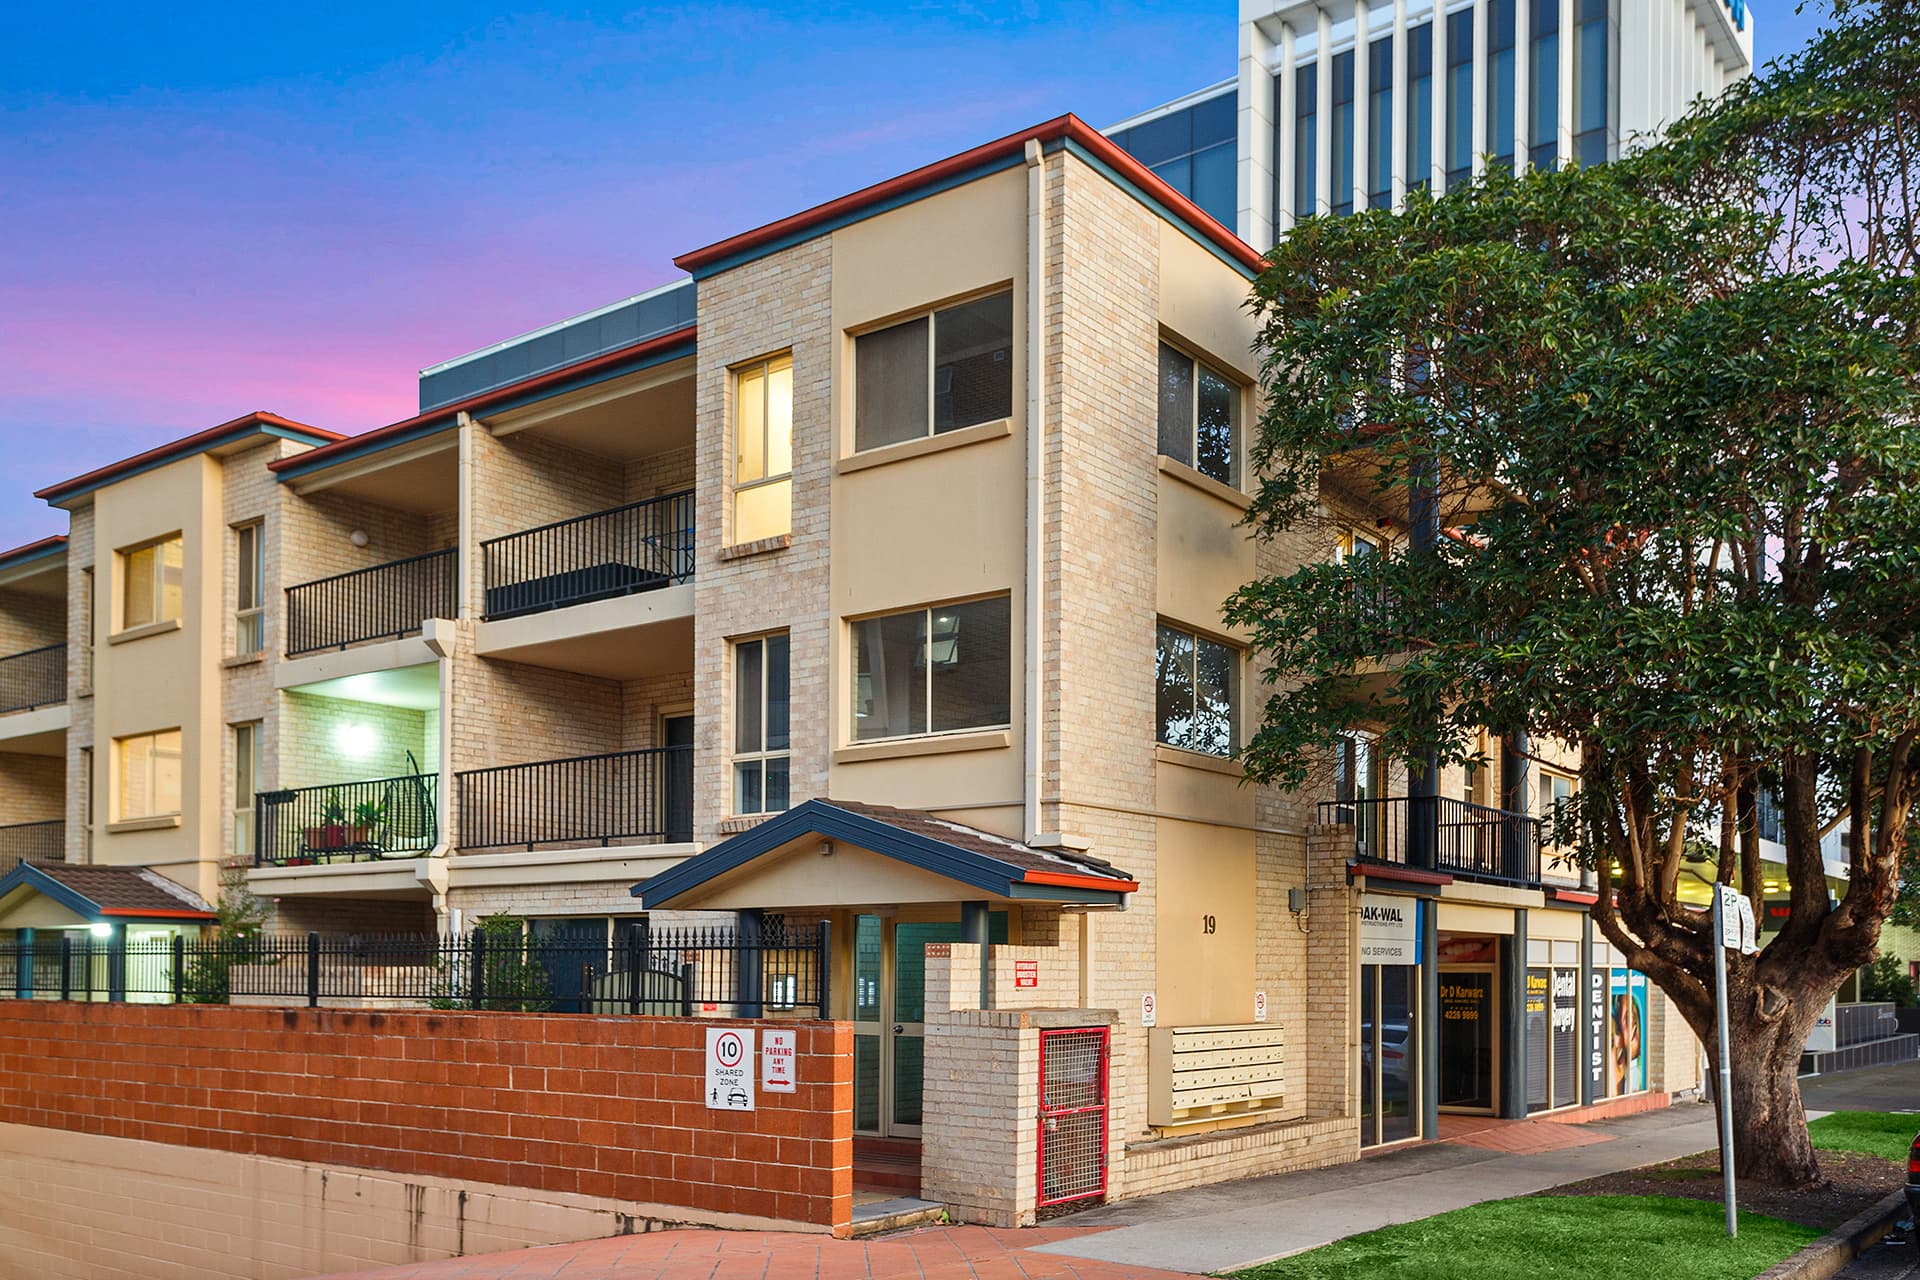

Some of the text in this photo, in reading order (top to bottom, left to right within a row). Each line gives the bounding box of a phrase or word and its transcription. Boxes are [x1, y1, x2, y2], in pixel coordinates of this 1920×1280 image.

[1724, 892, 1738, 907] 2P
[1202, 914, 1216, 935] 19
[1361, 946, 1402, 957] NG SERVICES
[1552, 970, 1576, 998] Dental
[1440, 985, 1448, 998] Dr
[1449, 985, 1455, 998] D
[1592, 974, 1603, 1081] DENTIST
[775, 1037, 783, 1045] NO
[721, 1041, 737, 1057] 10
[765, 1047, 792, 1056] PARKING
[715, 1069, 744, 1077] SHARED
[772, 1066, 786, 1074] TIME
[720, 1078, 739, 1086] ZONE
